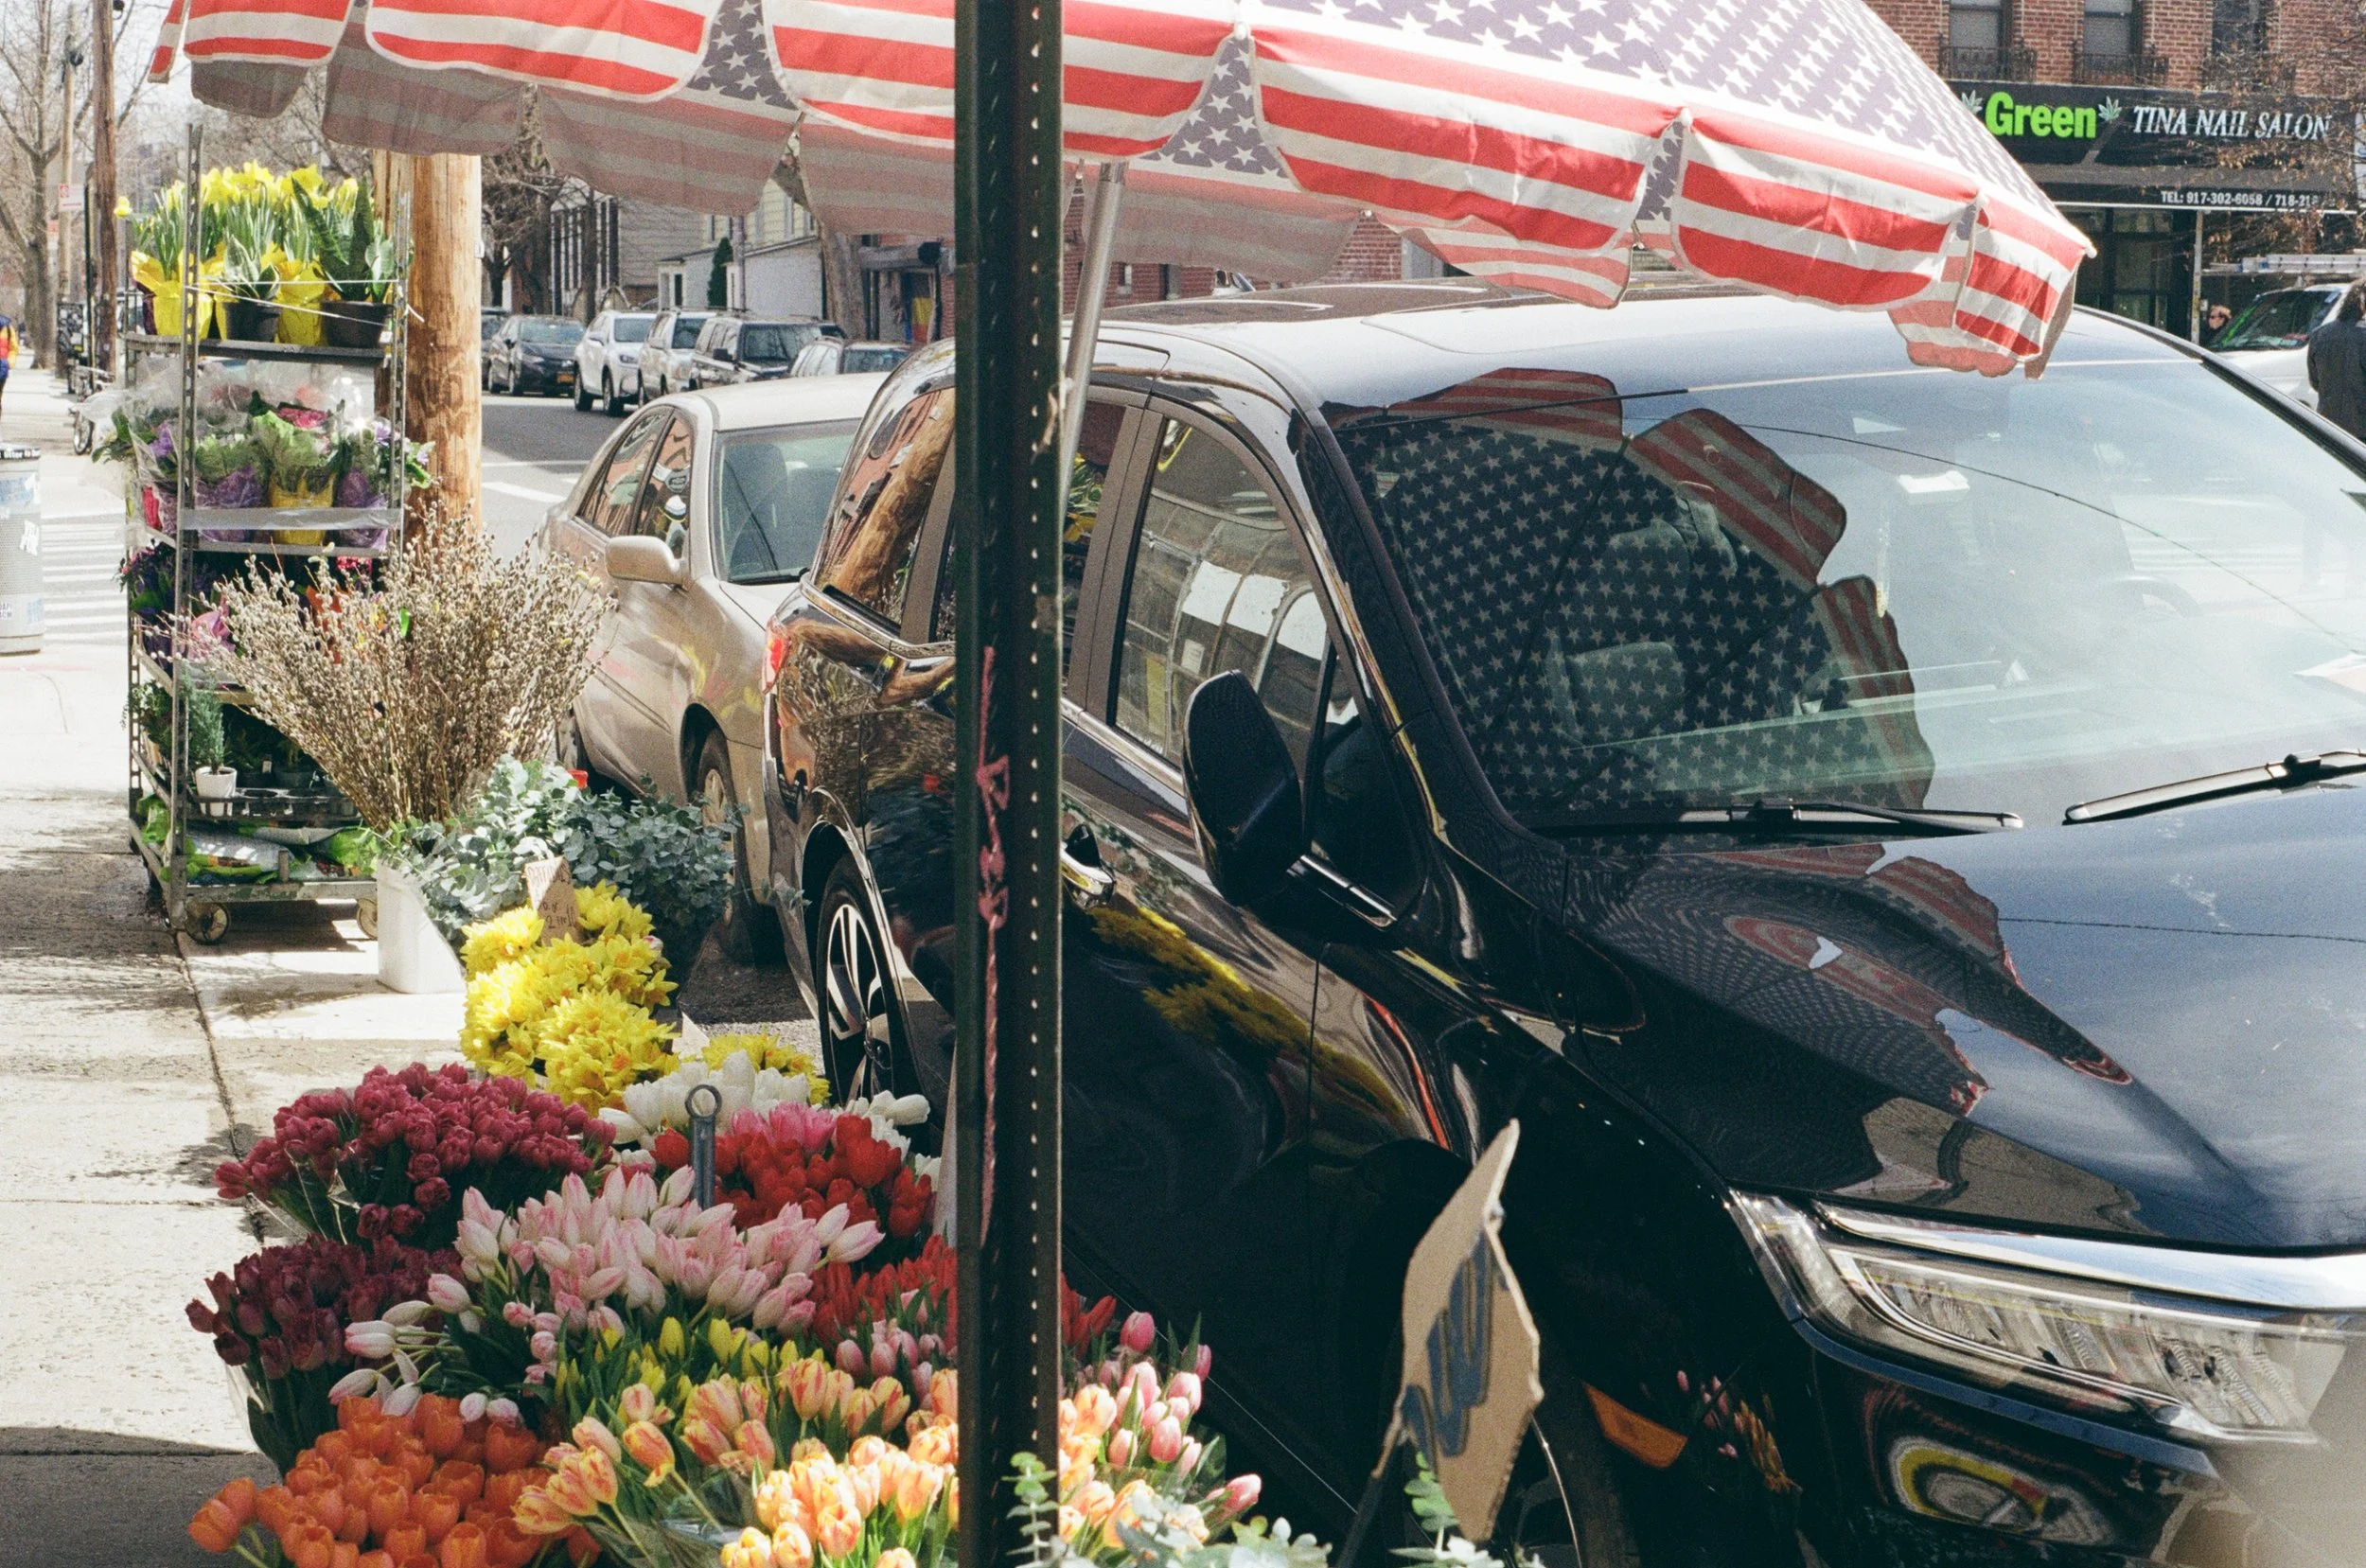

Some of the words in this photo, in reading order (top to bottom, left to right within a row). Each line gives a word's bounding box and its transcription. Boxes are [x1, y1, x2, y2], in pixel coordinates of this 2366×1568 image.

[1986, 91, 2096, 138] Green
[2133, 105, 2187, 134] TINA
[2194, 109, 2249, 137] NAIL
[2254, 112, 2332, 140] SALON
[2161, 190, 2183, 203] TEL:
[2186, 192, 2263, 205] 917-302-6058
